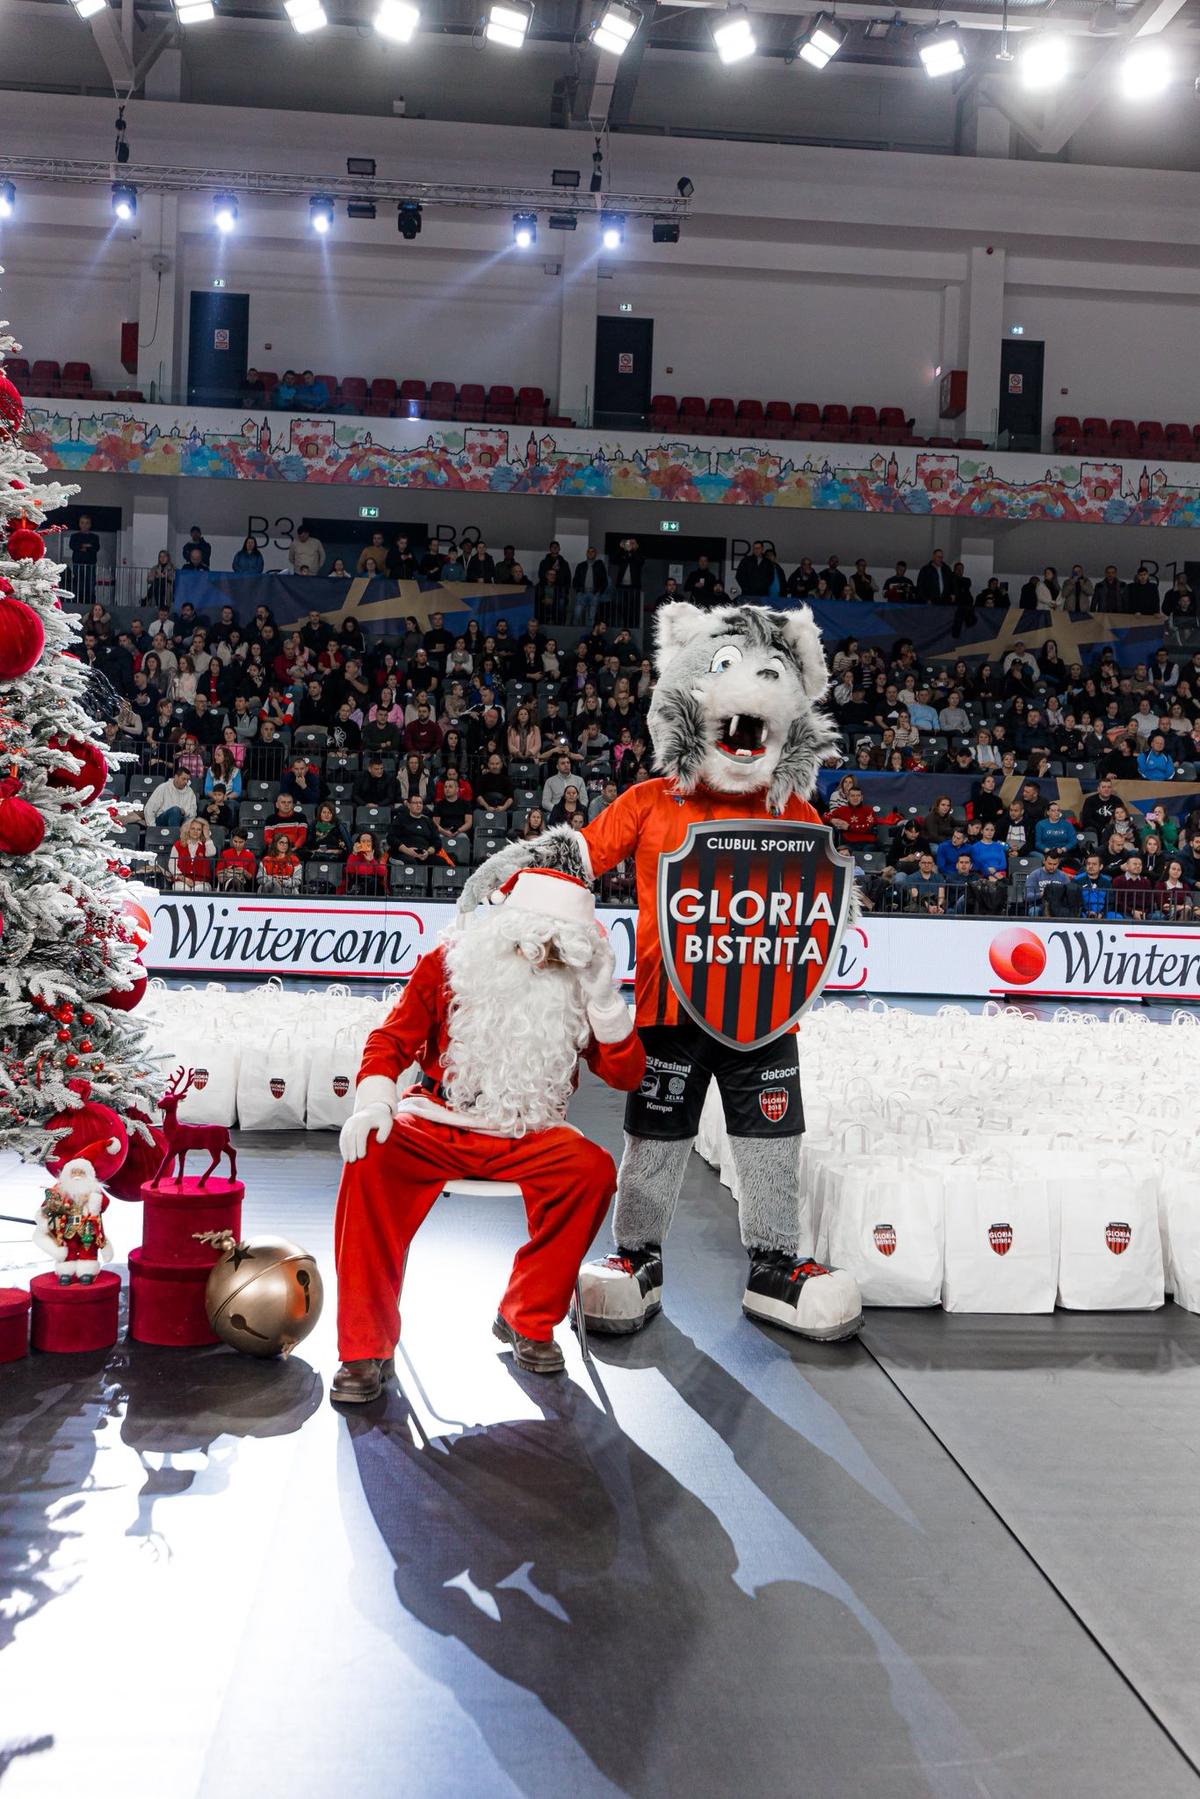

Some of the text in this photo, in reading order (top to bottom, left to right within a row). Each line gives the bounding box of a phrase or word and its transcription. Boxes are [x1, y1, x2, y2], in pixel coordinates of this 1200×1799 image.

[249, 515, 295, 550] B3
[707, 837, 815, 852] CLUBUL SPORTIV
[669, 888, 836, 927] GLORIA
[154, 902, 411, 965] Wintercom
[1047, 930, 1200, 987] Winter
[653, 1058, 692, 1074] Frasinul
[646, 1101, 673, 1113] Kempa
[762, 1097, 786, 1105] GLORIA
